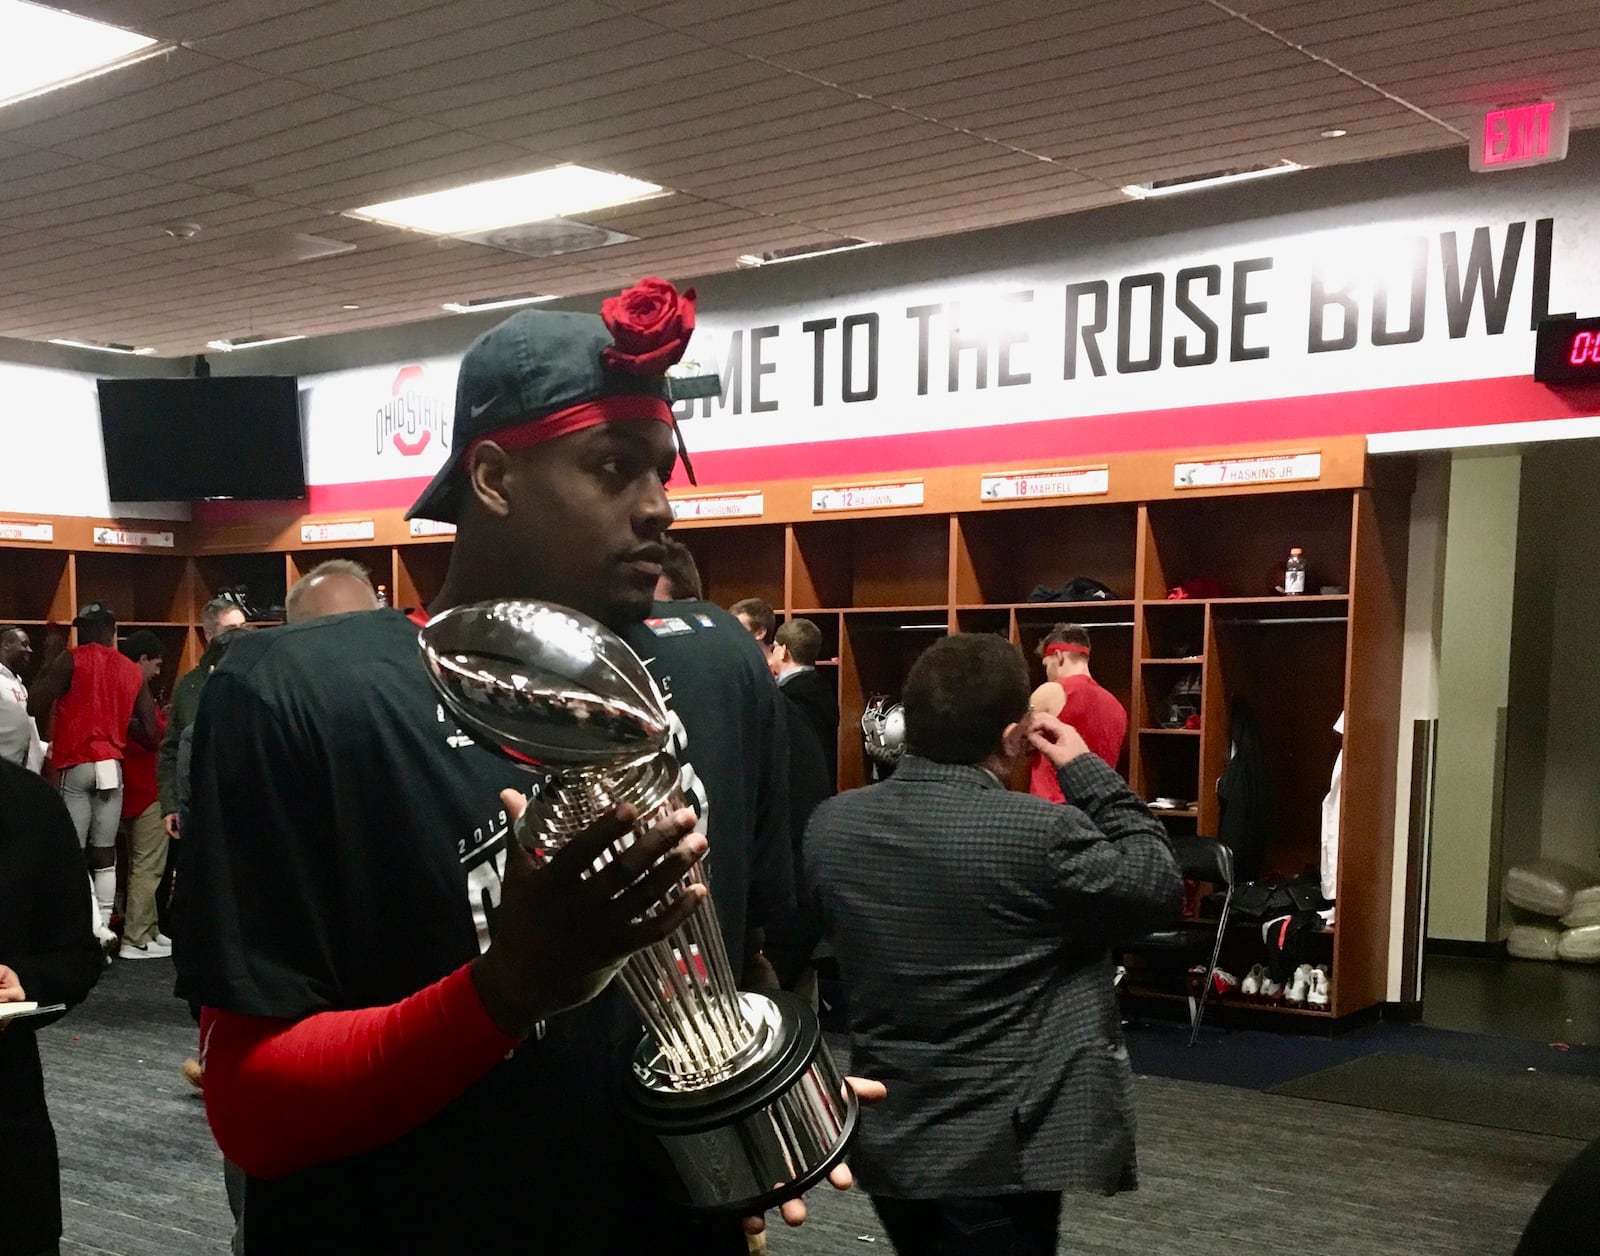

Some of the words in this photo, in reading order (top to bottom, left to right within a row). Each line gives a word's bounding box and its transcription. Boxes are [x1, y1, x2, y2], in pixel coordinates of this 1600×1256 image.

[1483, 102, 1556, 165] EXIT
[803, 313, 879, 407] TO
[906, 289, 1034, 396] THE
[1063, 256, 1274, 381] ROSE
[1307, 218, 1577, 354] BOWL
[1014, 480, 1027, 496] 18
[1029, 483, 1072, 496] MARTELL
[1219, 465, 1228, 482] 7
[1230, 467, 1276, 481] HASKINS
[458, 810, 507, 854] 2019
